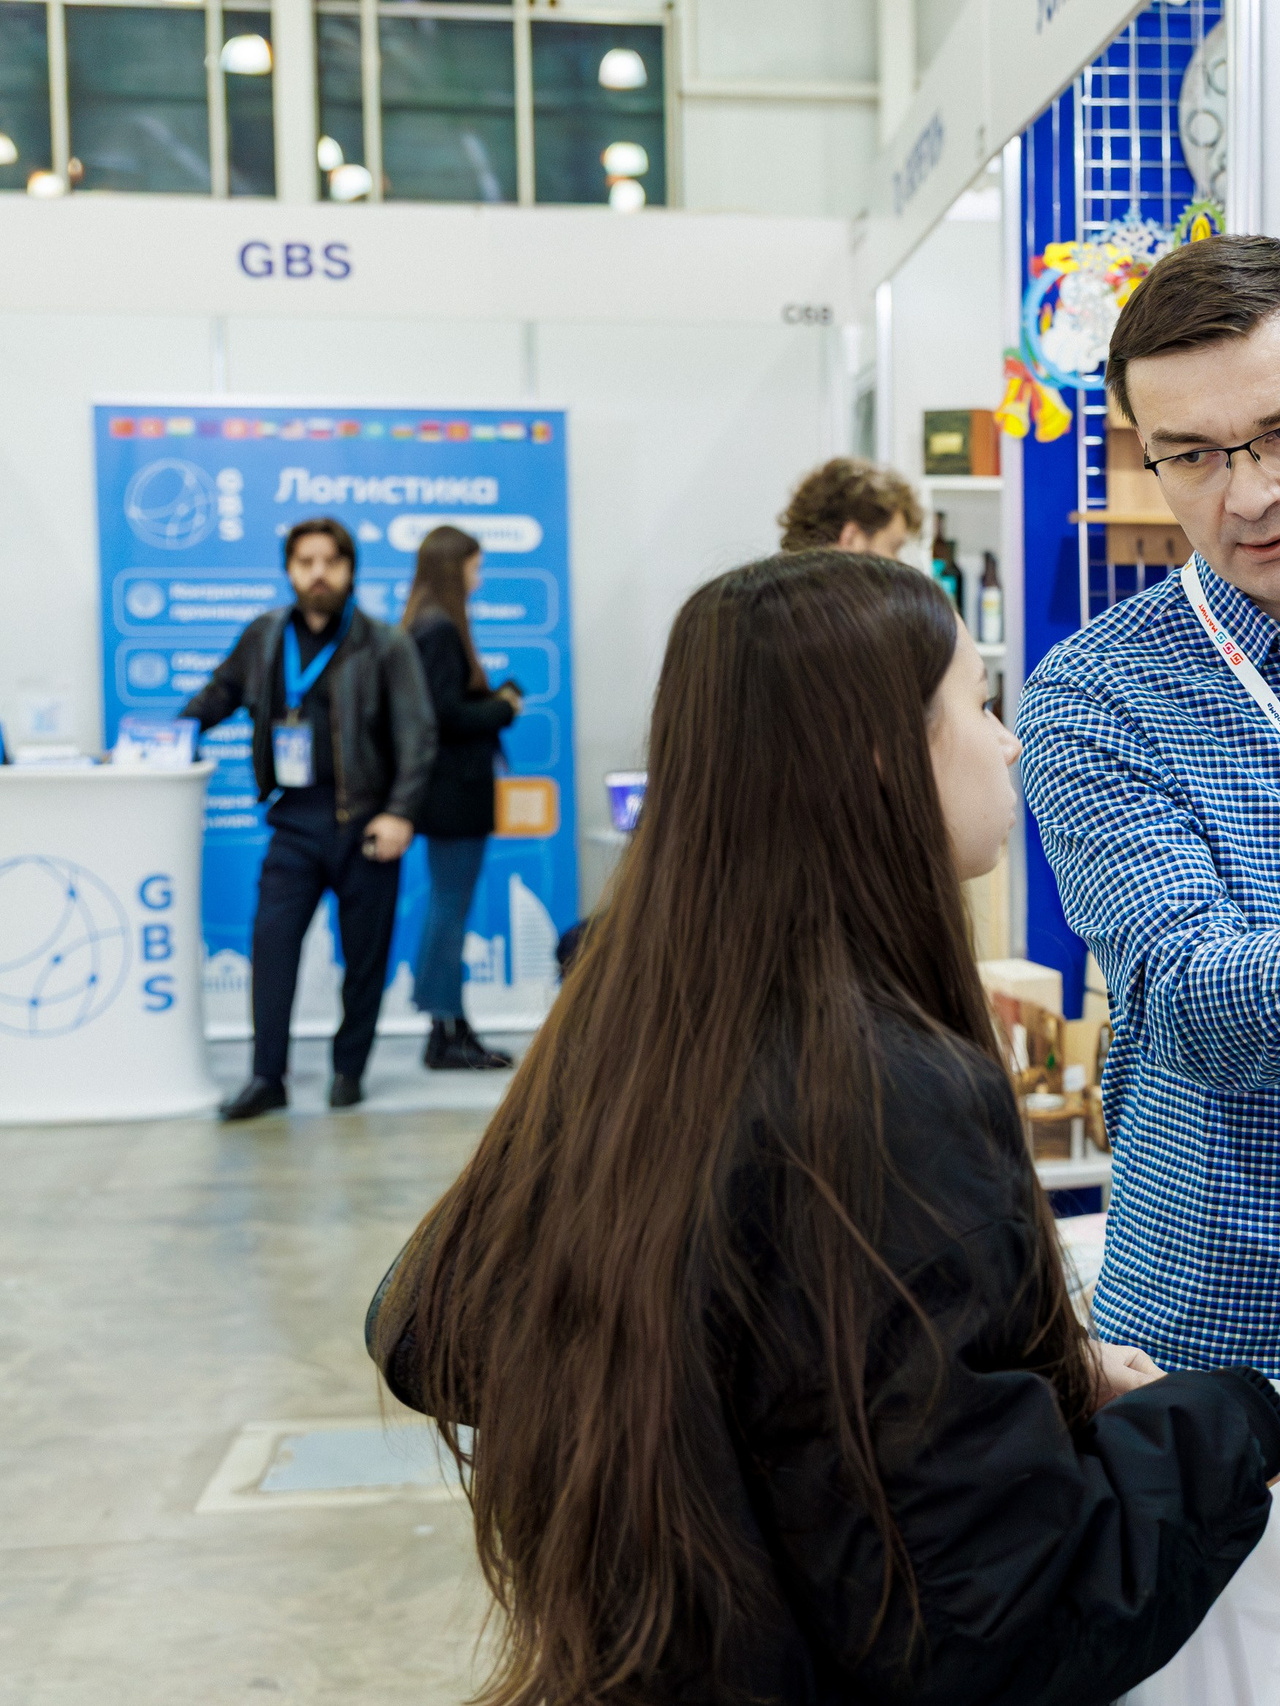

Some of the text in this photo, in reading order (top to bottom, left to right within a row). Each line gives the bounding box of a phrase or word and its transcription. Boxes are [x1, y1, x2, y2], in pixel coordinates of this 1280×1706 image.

[238, 241, 353, 281] GBS
[274, 467, 500, 506] Логистика
[1198, 604, 1218, 633] МАГНИТ
[138, 875, 174, 1012] GBS
